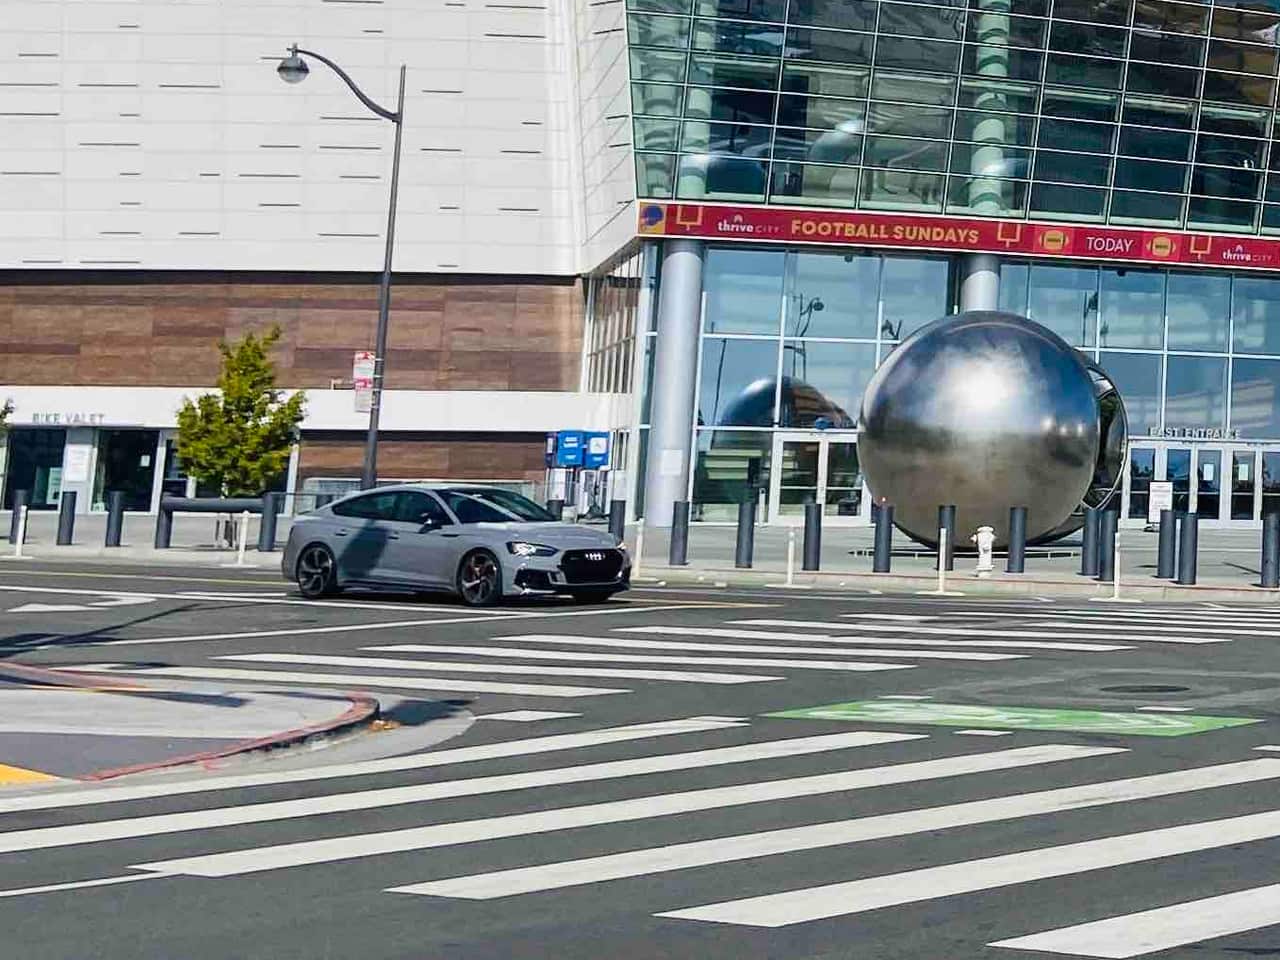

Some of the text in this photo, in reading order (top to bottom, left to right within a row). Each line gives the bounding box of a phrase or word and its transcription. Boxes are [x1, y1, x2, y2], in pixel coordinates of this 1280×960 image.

[717, 214, 754, 233] thrive
[791, 220, 980, 244] FOOTBALL SUNDAYS
[1086, 236, 1135, 253] TODAY
[1148, 426, 1178, 438] EAST
